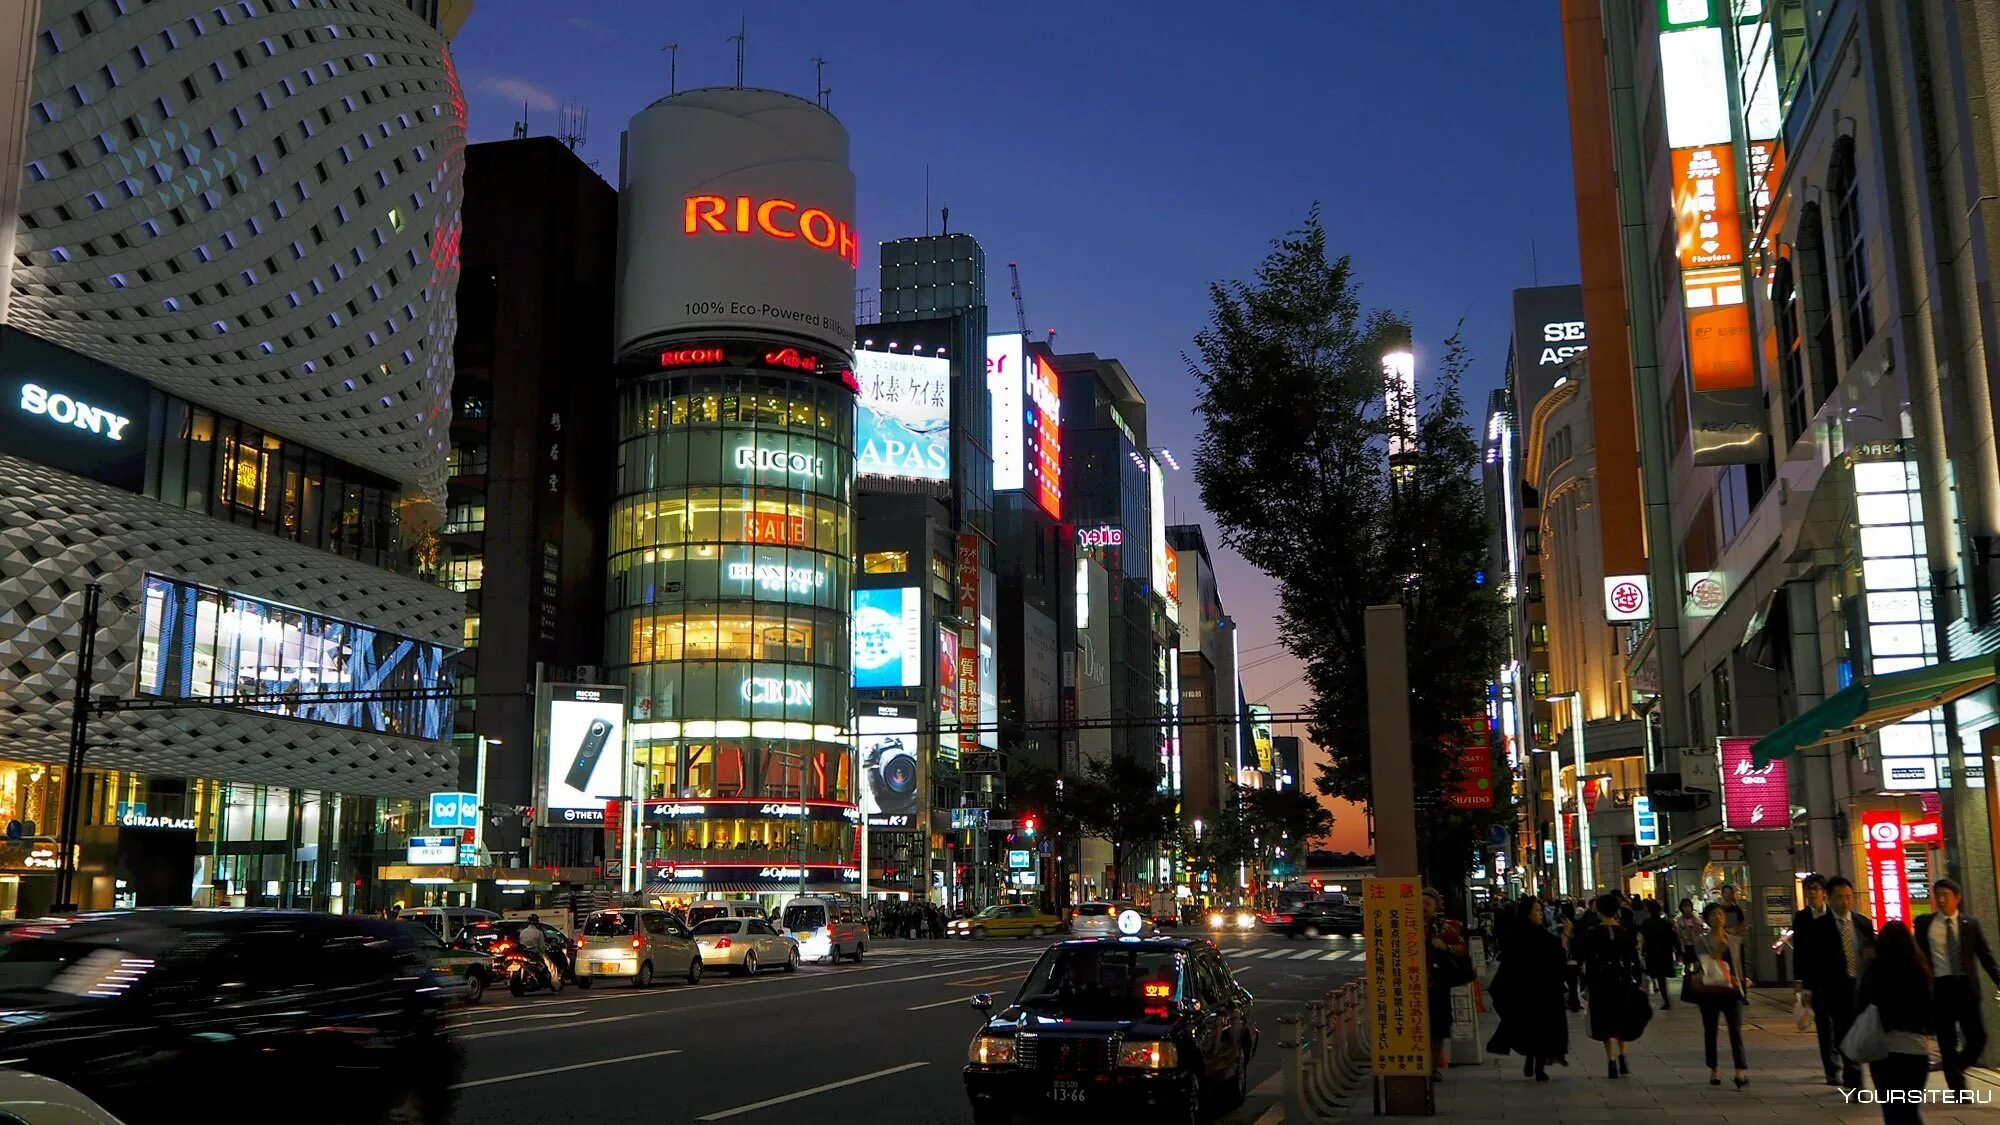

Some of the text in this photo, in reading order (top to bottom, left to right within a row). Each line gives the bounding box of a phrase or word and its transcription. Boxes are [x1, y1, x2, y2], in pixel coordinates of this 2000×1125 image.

[685, 195, 858, 269] RICOH
[685, 302, 724, 315] 100%
[731, 302, 819, 326] Eco-Powered
[662, 349, 722, 366] RICOH
[20, 383, 129, 441] SONY
[737, 447, 824, 478] RICOH
[747, 518, 805, 542] SALE
[960, 657, 975, 677] 質
[123, 815, 195, 830] GINZA PLACE
[575, 810, 603, 820] THETA
[1145, 985, 1170, 997] 空車
[1054, 1088, 1086, 1102] 13-66
